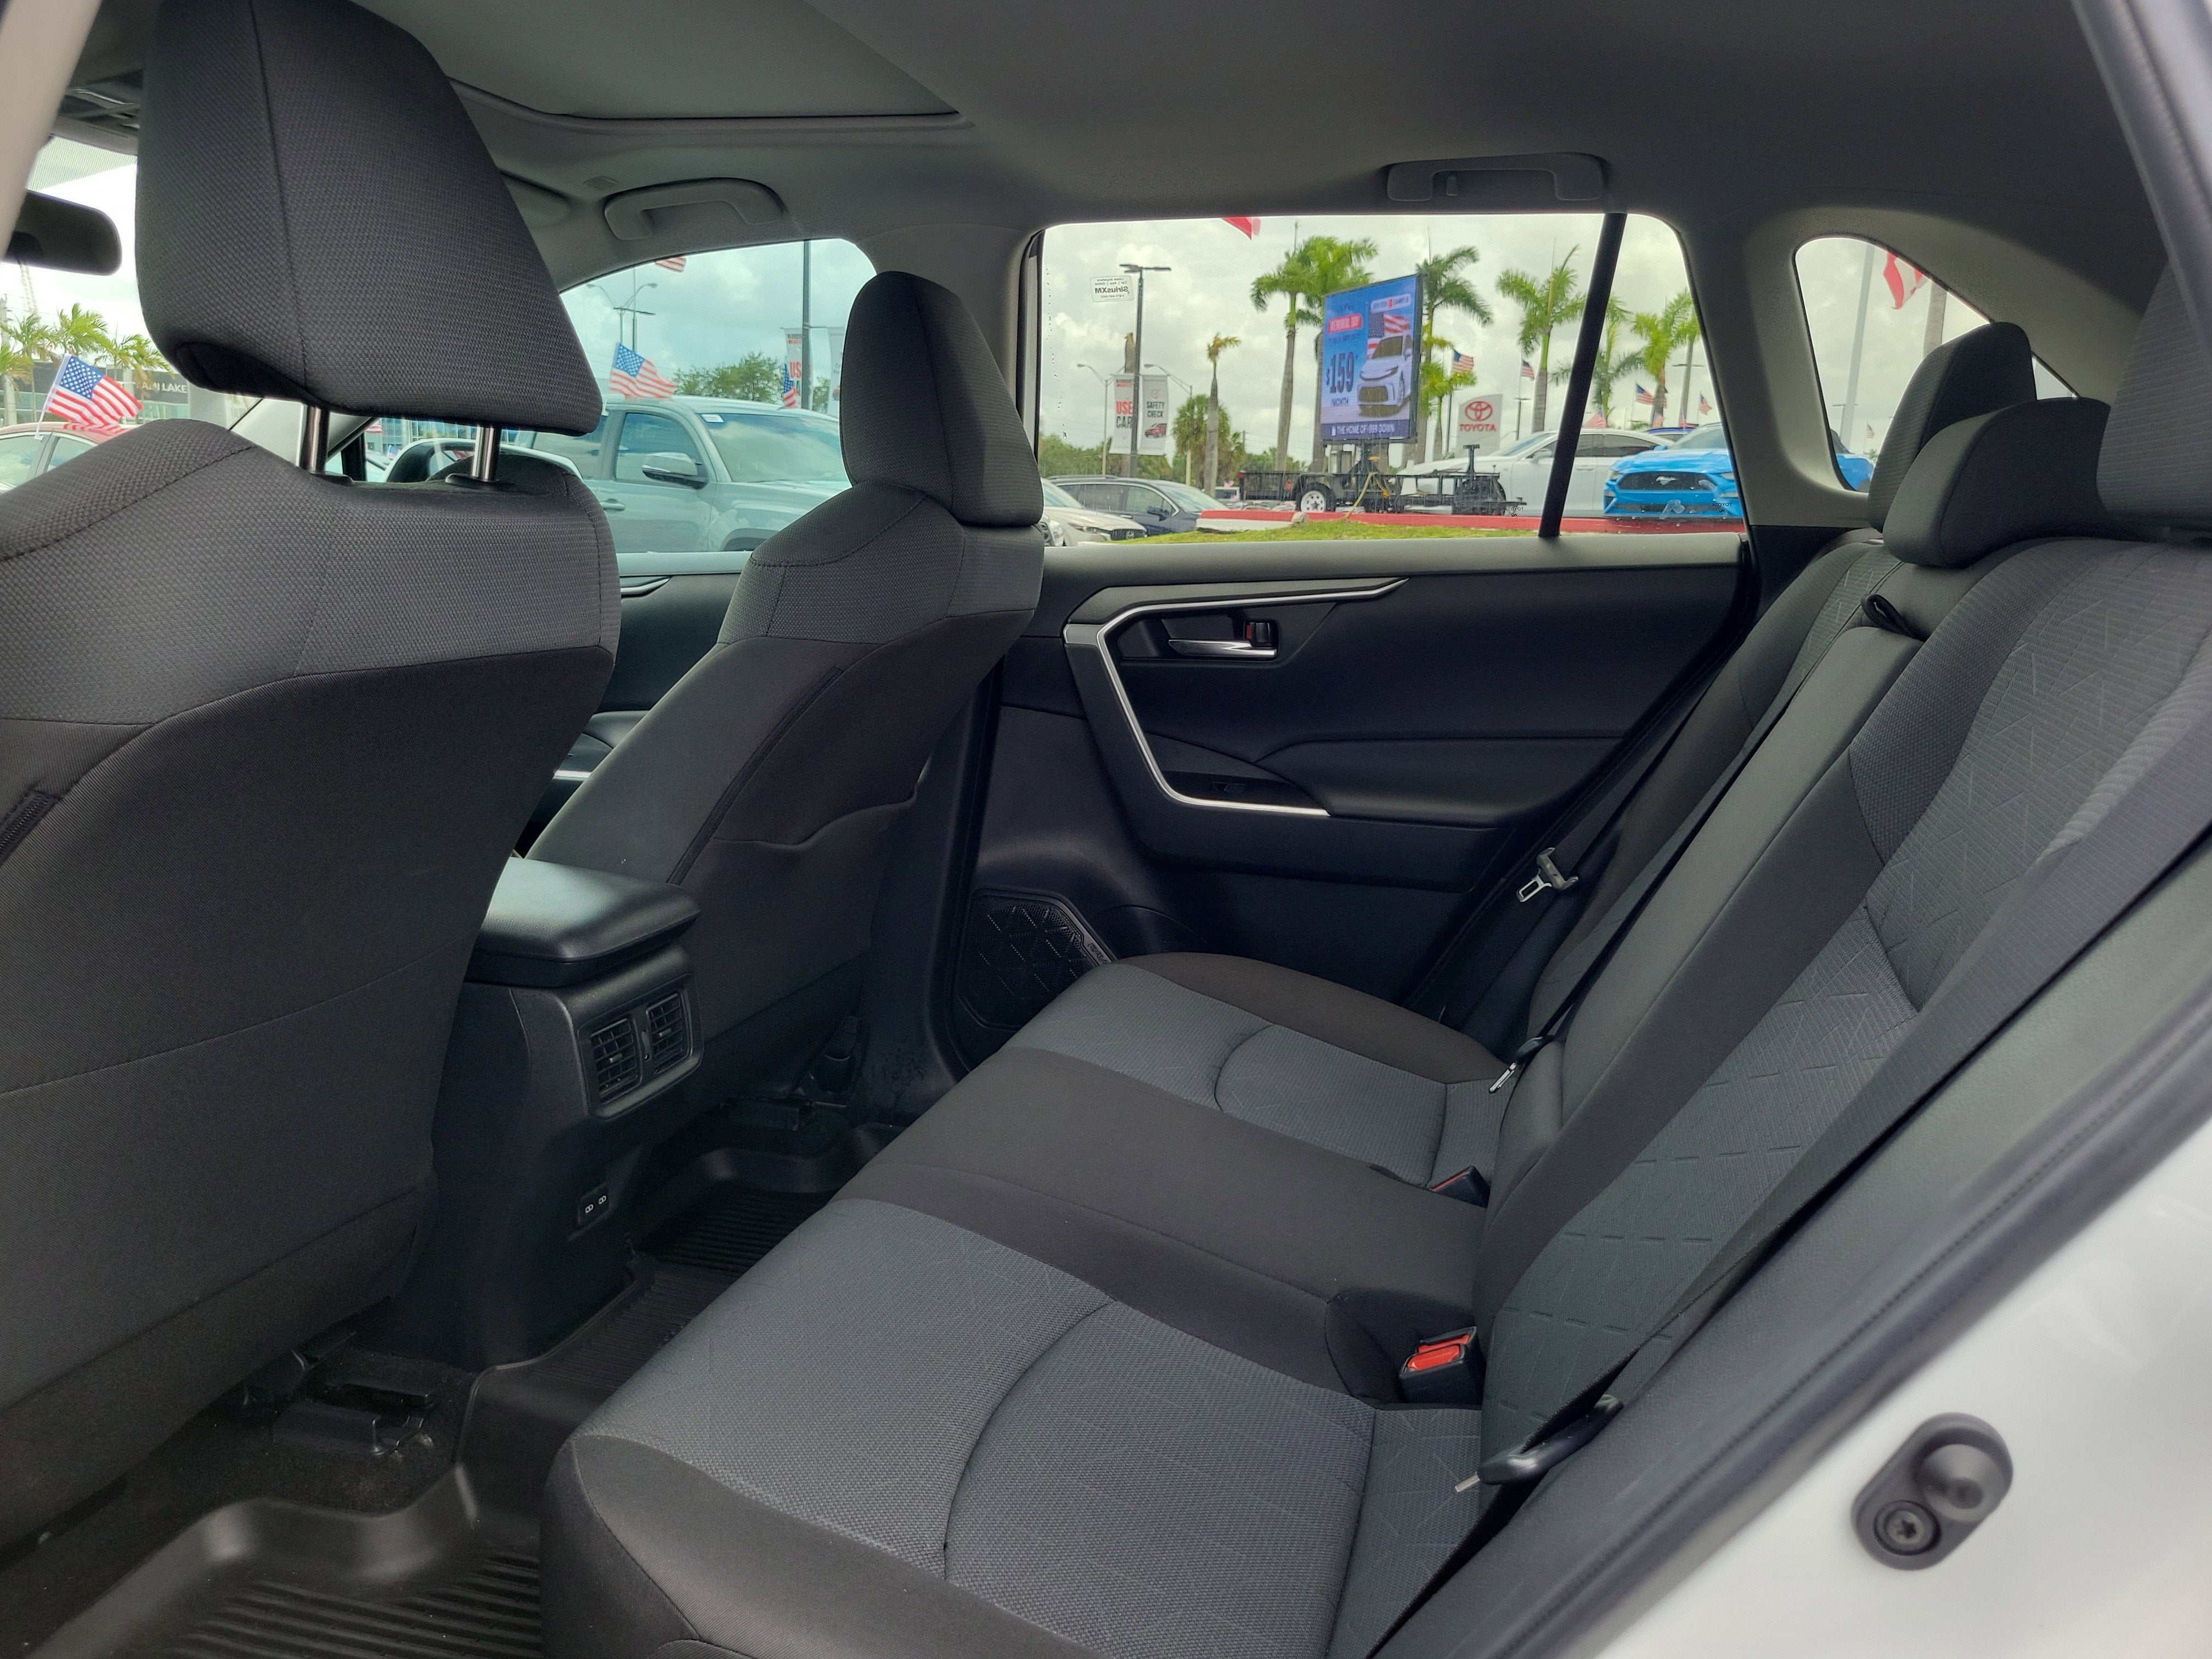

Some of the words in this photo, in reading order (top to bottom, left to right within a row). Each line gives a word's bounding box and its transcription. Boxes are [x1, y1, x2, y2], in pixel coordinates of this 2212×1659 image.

[789, 362, 801, 377] US
[162, 382, 188, 393] LAKE
[1116, 401, 1132, 415] USE
[1116, 416, 1132, 428] CAR
[1088, 943, 1107, 964] RAV
